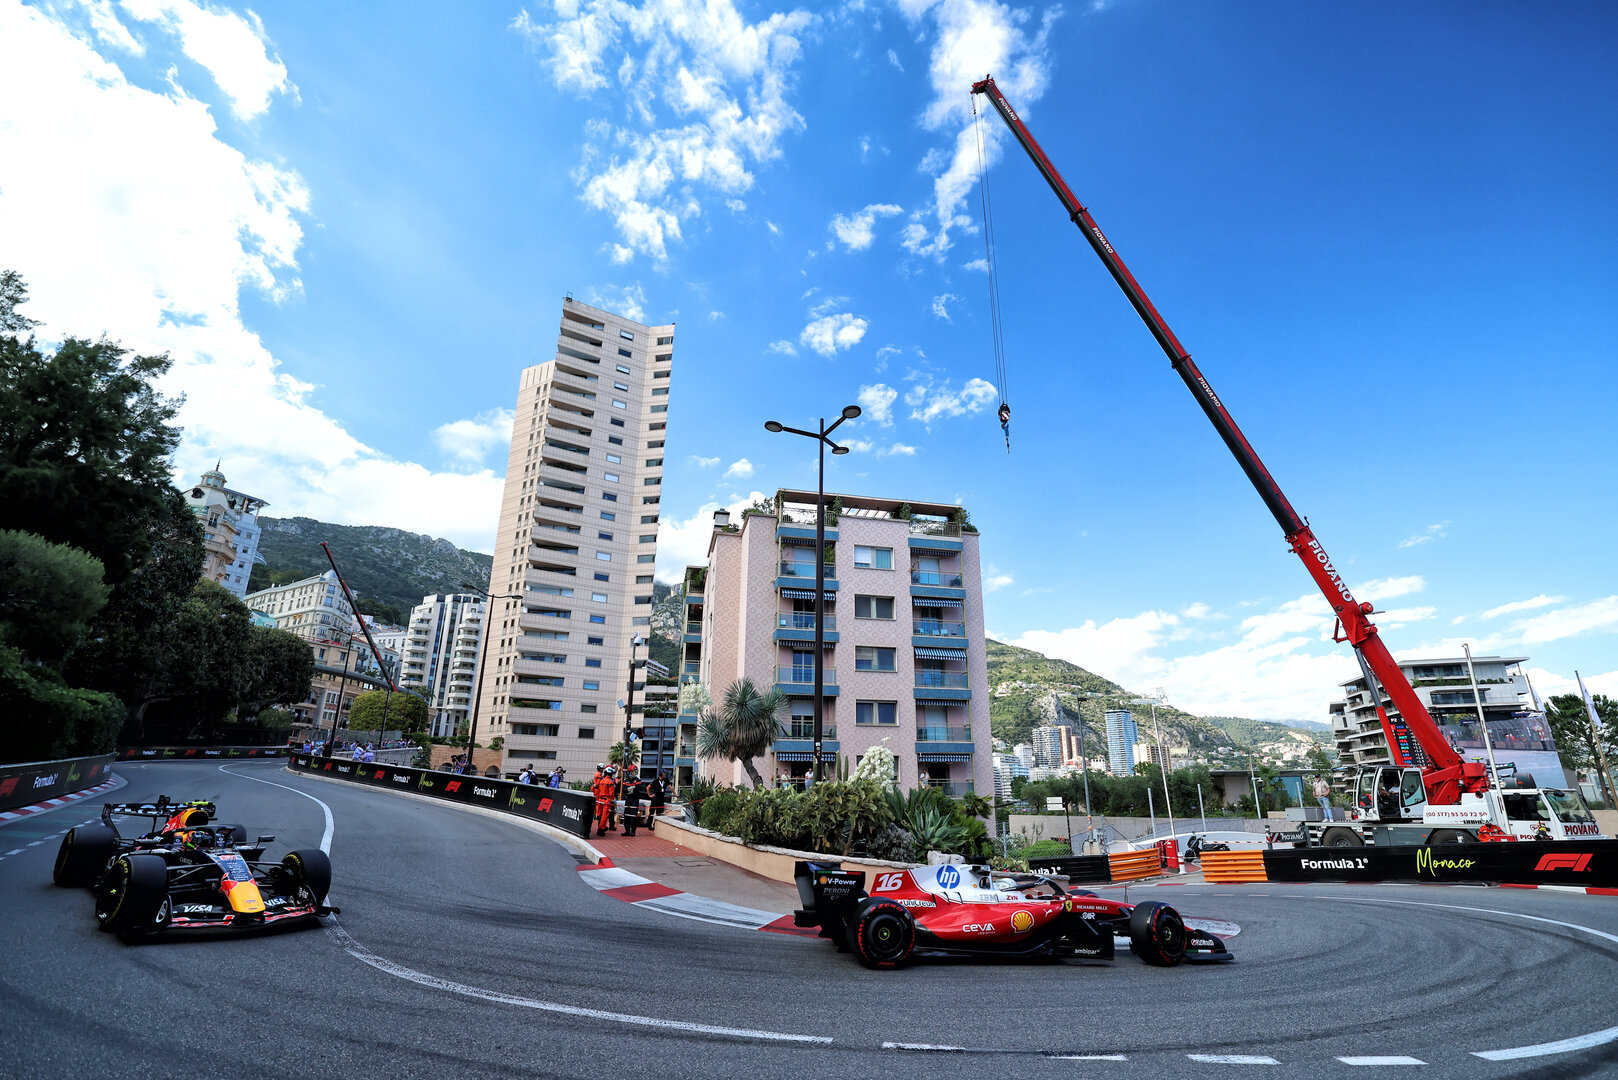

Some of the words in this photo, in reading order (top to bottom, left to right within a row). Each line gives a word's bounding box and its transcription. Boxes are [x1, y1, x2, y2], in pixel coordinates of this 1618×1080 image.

[1092, 227, 1114, 253] PIOVANO
[1197, 376, 1221, 407] PIOVANO
[1308, 539, 1353, 602] PIOVANO
[473, 786, 491, 797] Formula
[562, 805, 577, 820] Formula
[1564, 825, 1599, 836] PIOVANO
[1301, 858, 1354, 869] Formula
[1417, 847, 1476, 877] Monaco
[1534, 853, 1594, 872] F1
[827, 877, 857, 885] V-Power
[876, 873, 904, 892] 16
[939, 866, 958, 888] hp
[183, 904, 213, 912] VISA
[264, 898, 287, 906] VISA
